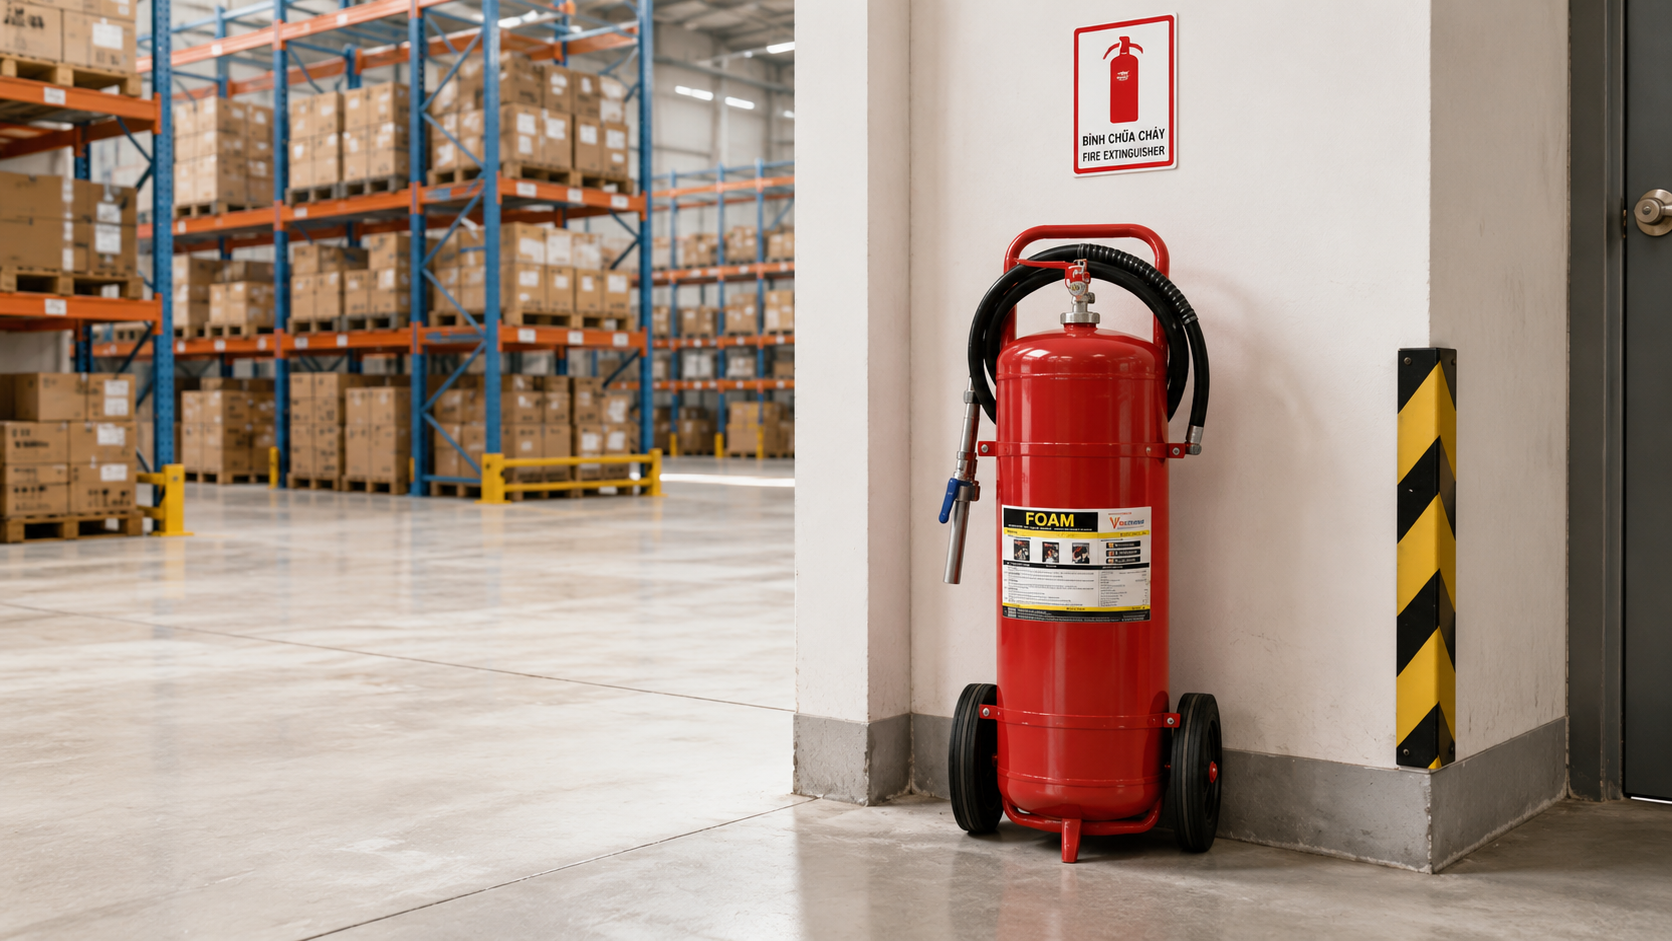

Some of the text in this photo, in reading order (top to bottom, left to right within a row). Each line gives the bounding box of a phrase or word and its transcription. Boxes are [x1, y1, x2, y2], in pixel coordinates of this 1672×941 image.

[1083, 146, 1165, 162] FIRE EXTINGUISHER
[1025, 511, 1075, 527] FOAM
